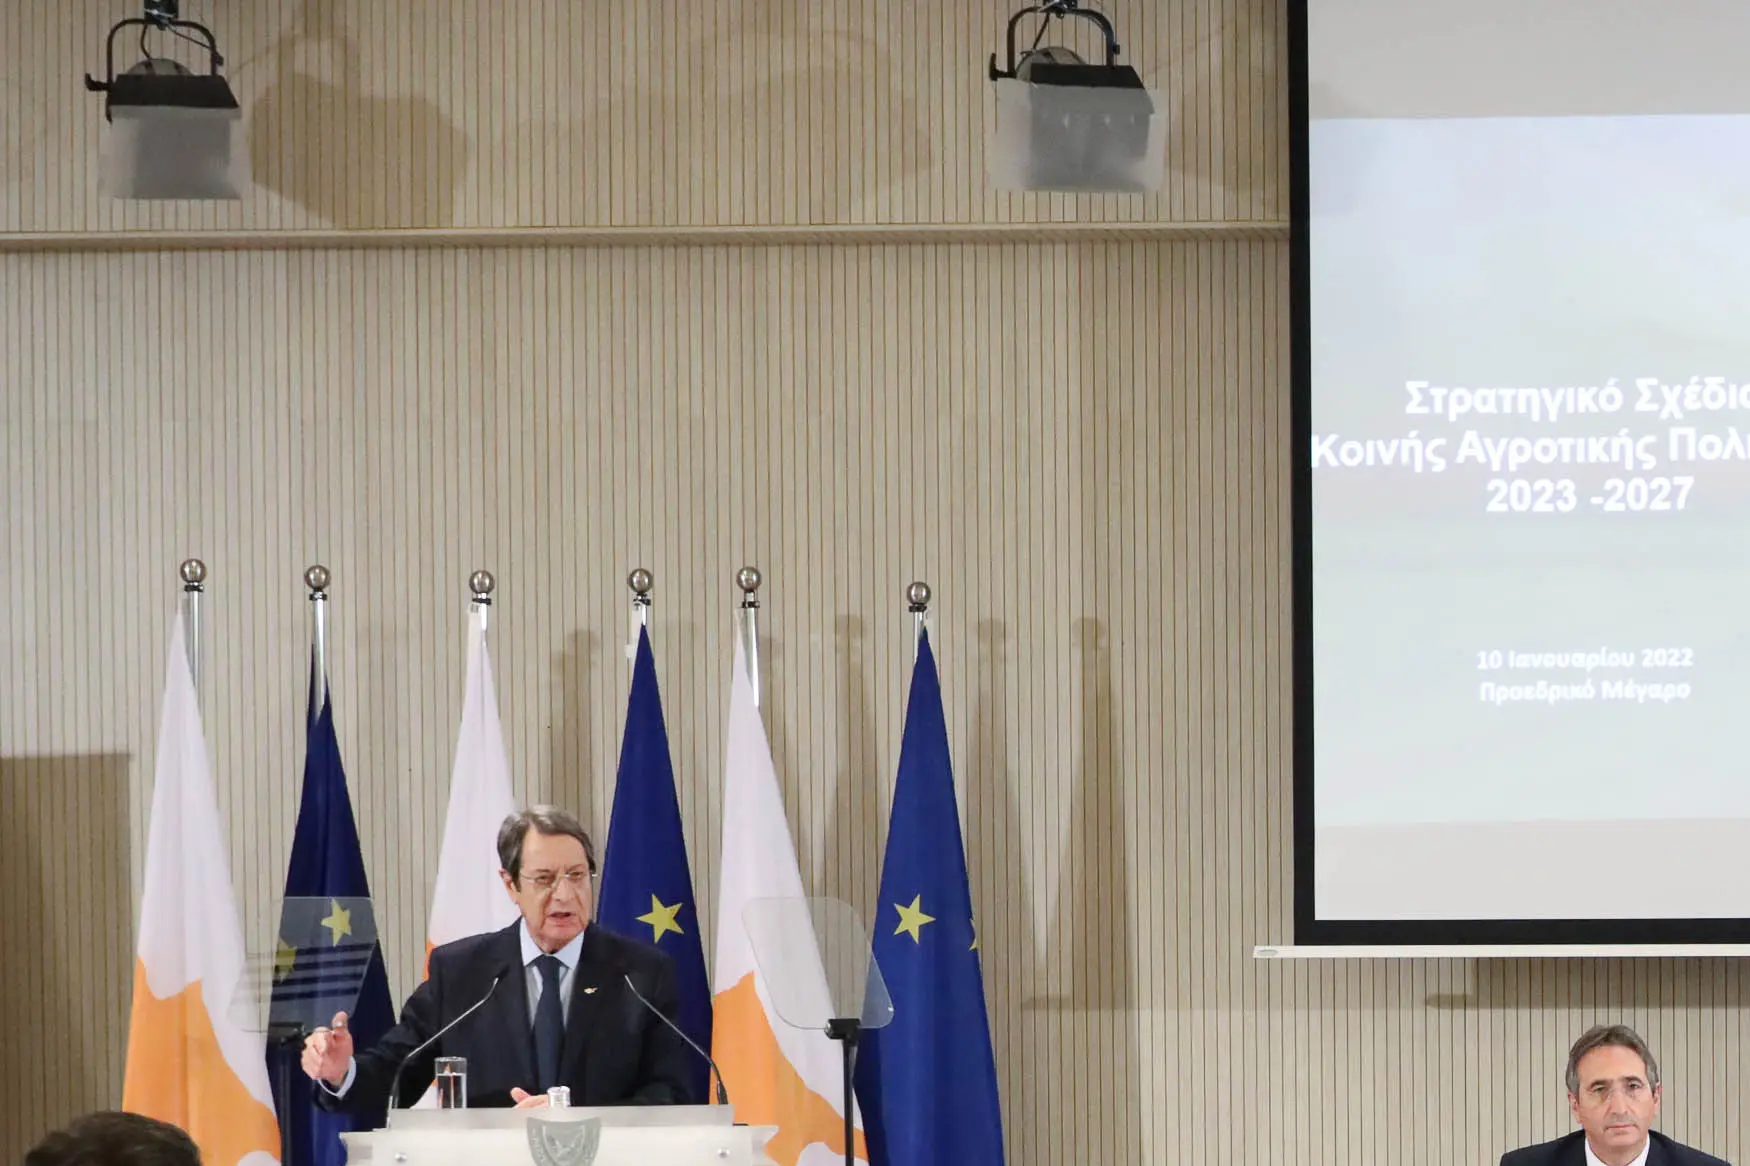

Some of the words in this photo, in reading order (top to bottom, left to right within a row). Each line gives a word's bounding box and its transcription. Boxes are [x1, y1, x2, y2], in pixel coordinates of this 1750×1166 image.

[1405, 378, 1624, 422] Στρατηγικό
[1311, 430, 1447, 473] Κοινής
[1456, 428, 1657, 471] Αγροτικής
[1486, 479, 1577, 512] 2023
[1476, 650, 1503, 670] 10
[1508, 646, 1635, 672] Ιανουαρίου
[1641, 648, 1694, 668] 2022
[1479, 678, 1596, 705] Προεδρικό
[1601, 678, 1692, 704] Μέγαρο
